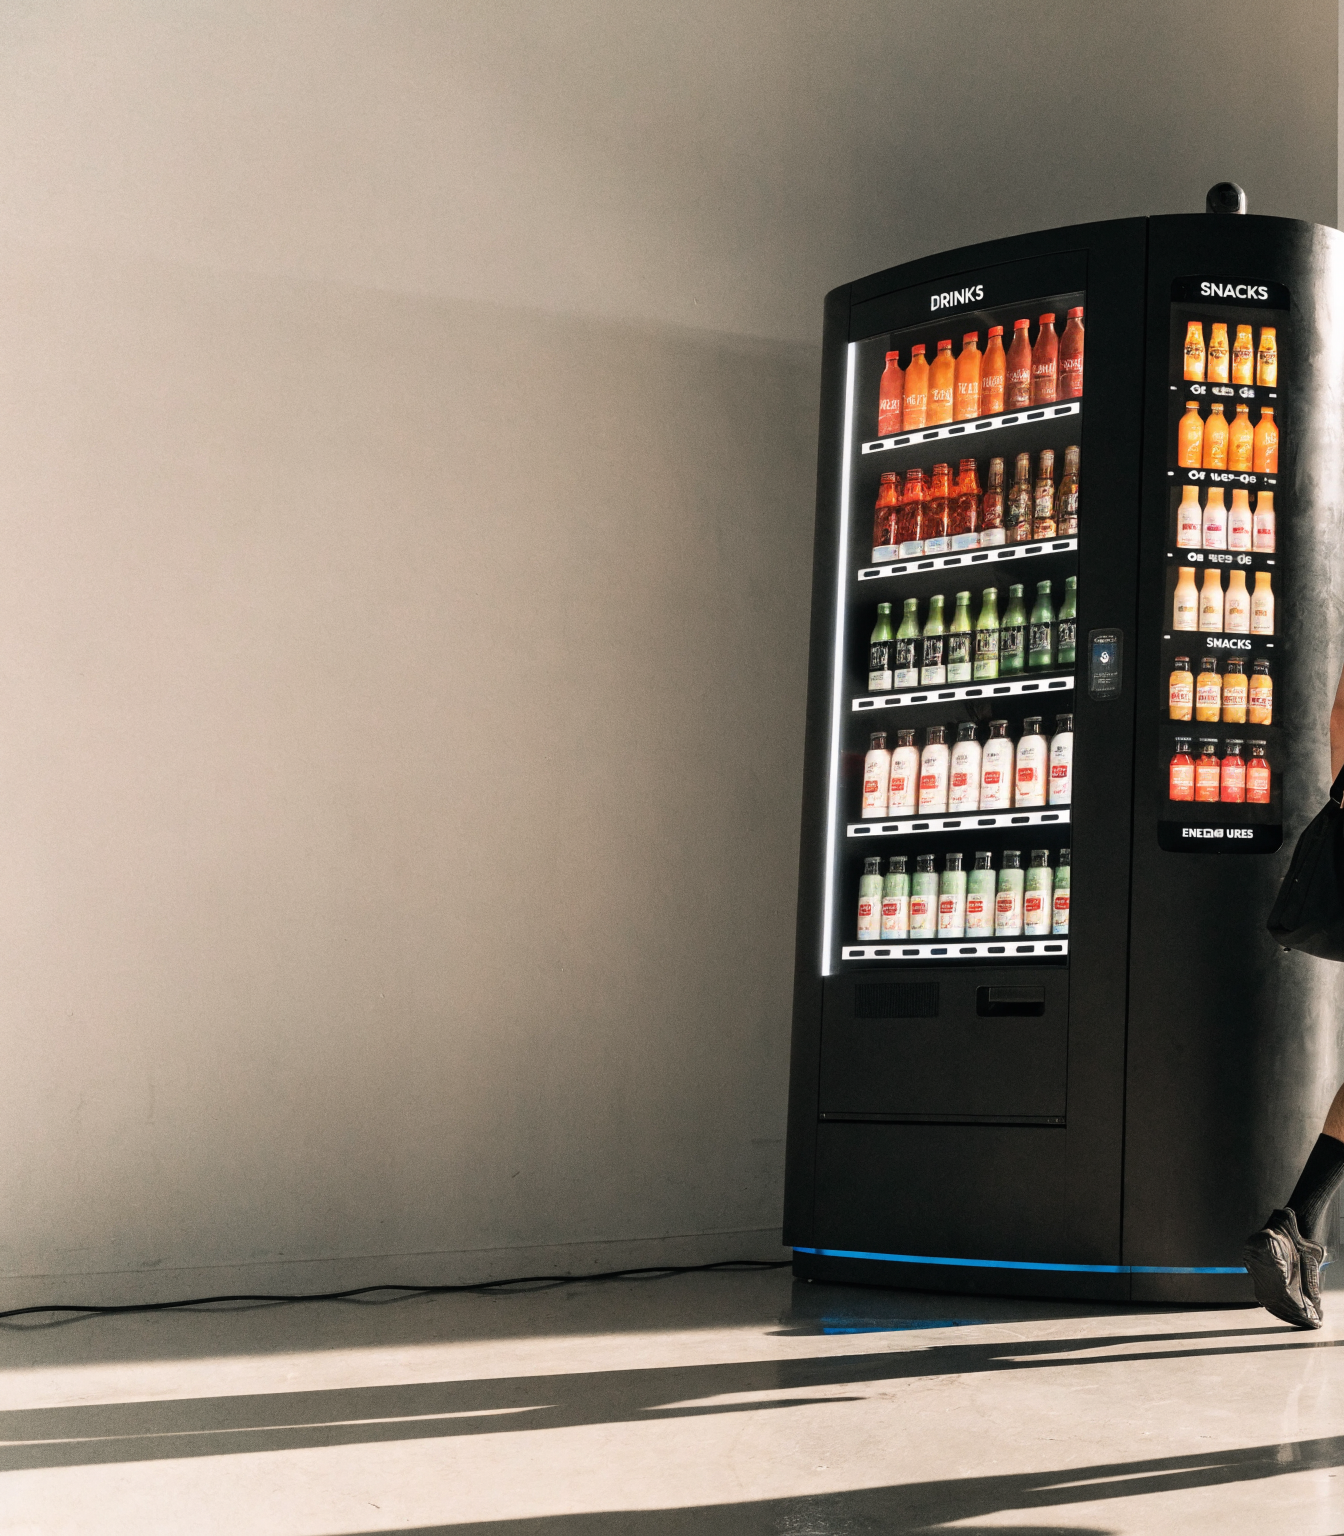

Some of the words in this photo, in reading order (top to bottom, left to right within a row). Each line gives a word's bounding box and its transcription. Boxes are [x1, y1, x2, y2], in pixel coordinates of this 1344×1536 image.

[930, 284, 984, 312] DRINKS
[1200, 281, 1269, 300] SNACKS
[1206, 637, 1252, 650] SNACKS
[1226, 828, 1254, 839] URES
